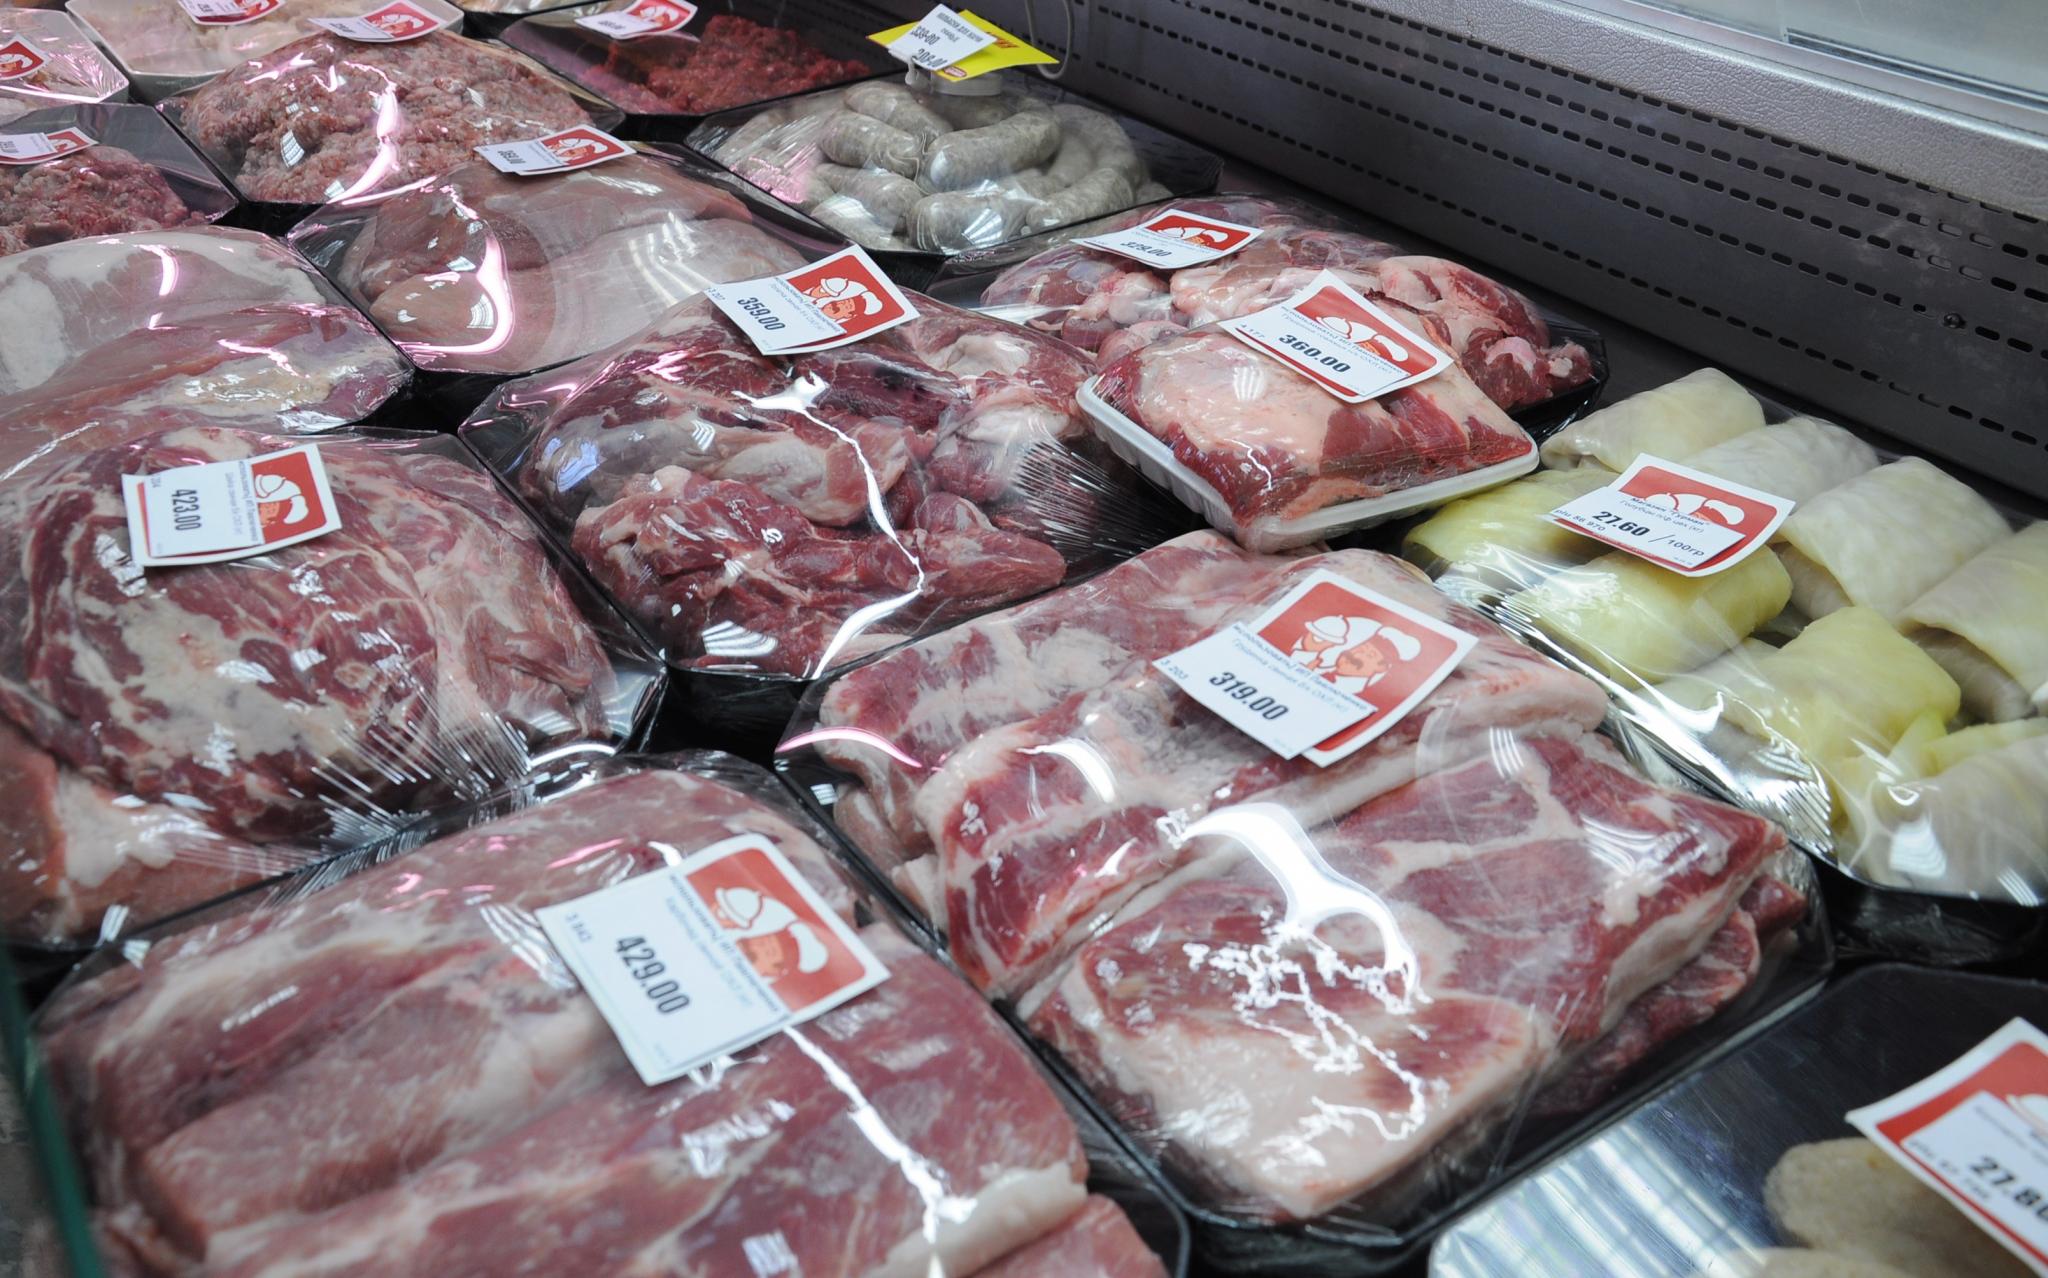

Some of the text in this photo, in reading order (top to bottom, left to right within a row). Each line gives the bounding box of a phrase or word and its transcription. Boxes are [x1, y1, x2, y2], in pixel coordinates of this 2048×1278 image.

[736, 297, 787, 331] 359.00
[1279, 334, 1351, 373] 360.00
[172, 489, 202, 531] 423.00
[1592, 510, 1651, 537] 27.60
[1209, 671, 1289, 721] 319.00
[617, 935, 690, 1015] 429.00
